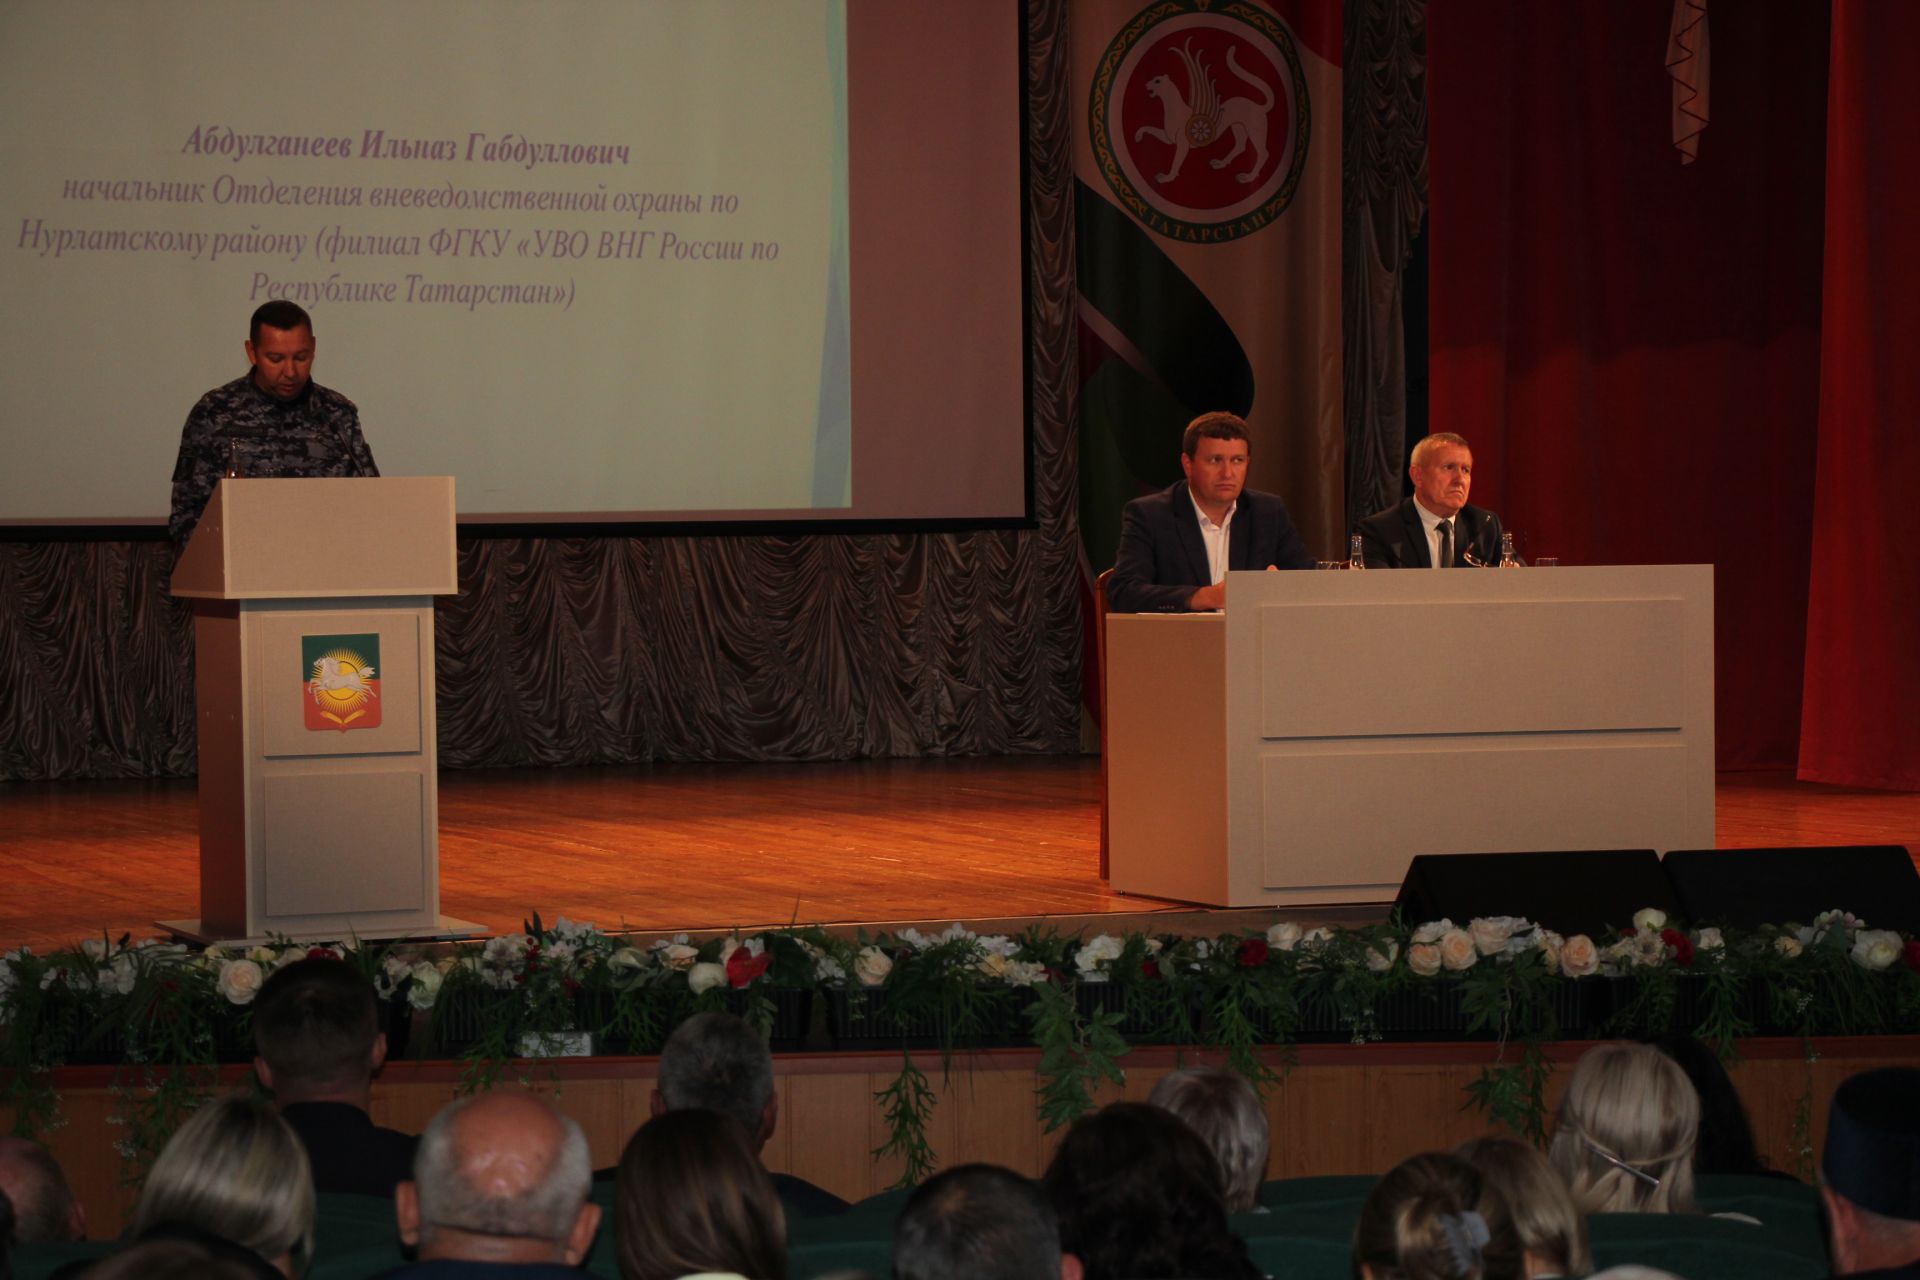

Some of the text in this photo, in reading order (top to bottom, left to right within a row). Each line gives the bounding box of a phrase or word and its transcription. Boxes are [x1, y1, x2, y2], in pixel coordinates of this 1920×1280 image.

[182, 124, 631, 169] Абдулганеев Ильназ Габдуллович
[62, 174, 739, 220] начальник Отделения вневедомственной охраны по
[17, 218, 780, 262] Нурлатскому району (филиал ФГКУ «УВО ВНГ России по
[1150, 213, 1266, 241] ТАТАРСТАН
[249, 271, 576, 312] Республике Татарстан»)
